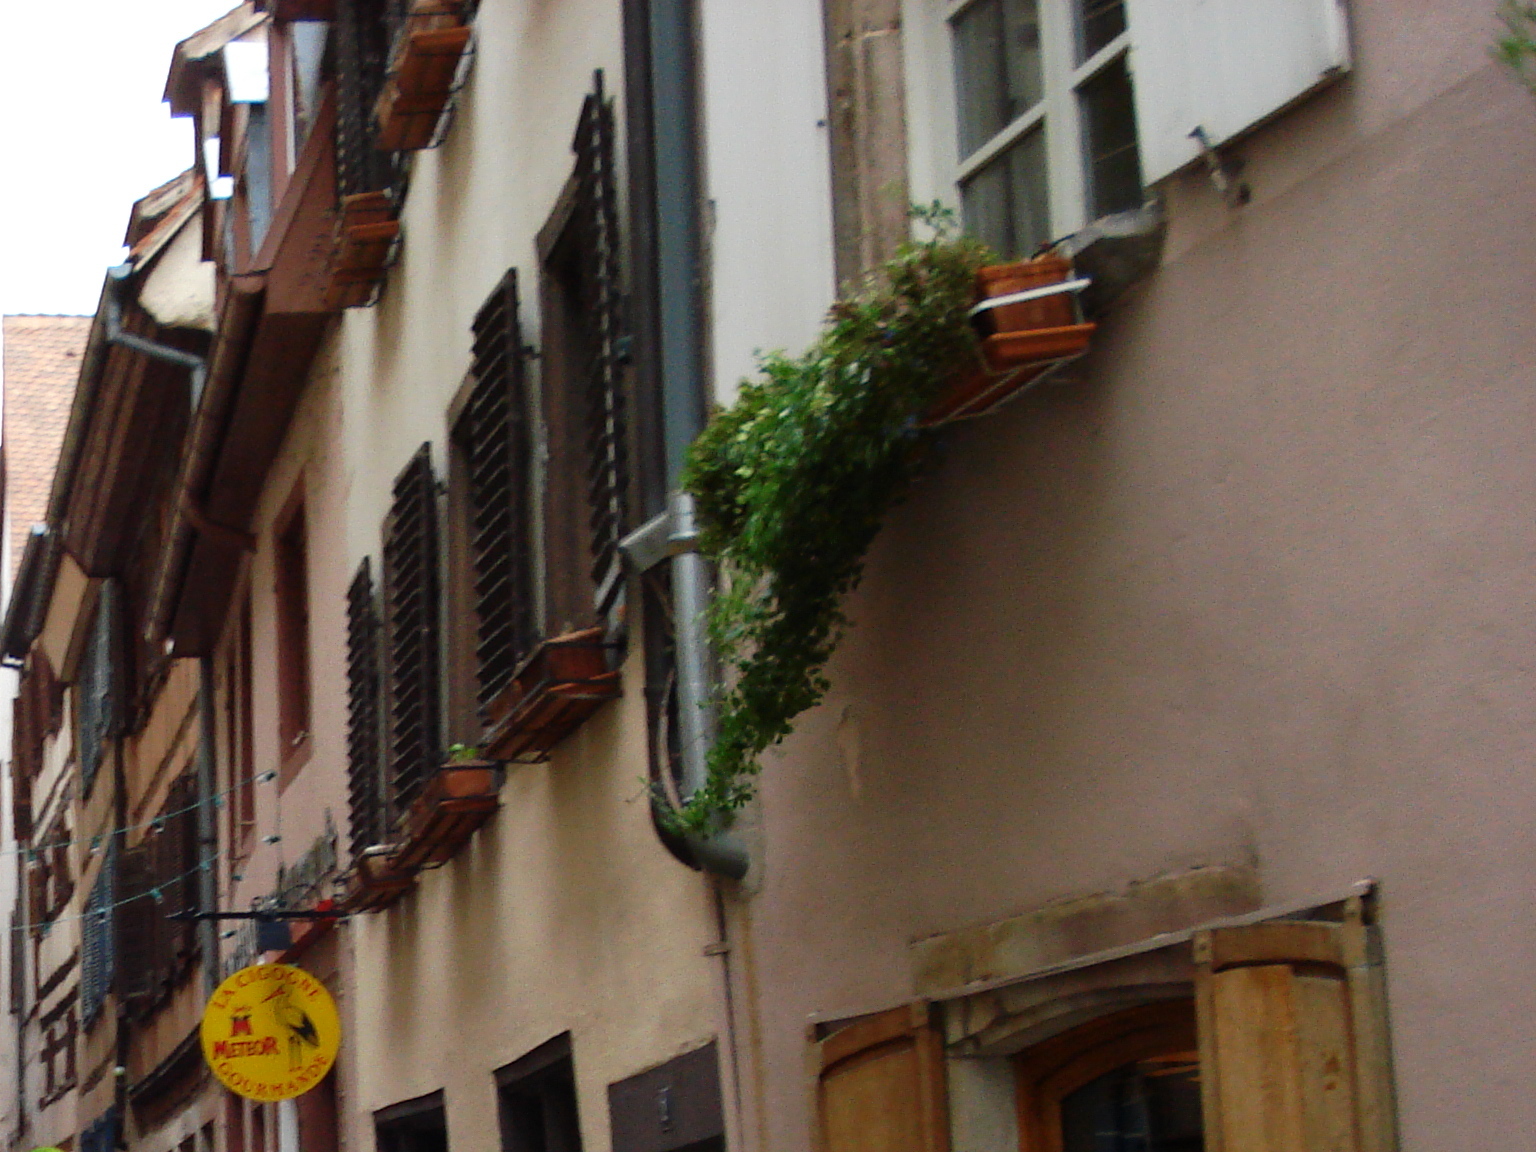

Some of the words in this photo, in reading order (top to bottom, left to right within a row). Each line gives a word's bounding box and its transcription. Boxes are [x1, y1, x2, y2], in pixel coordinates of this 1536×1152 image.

[213, 990, 236, 1009] LA
[213, 1036, 280, 1060] METEOR
[217, 1056, 328, 1097] GOURMANDE
